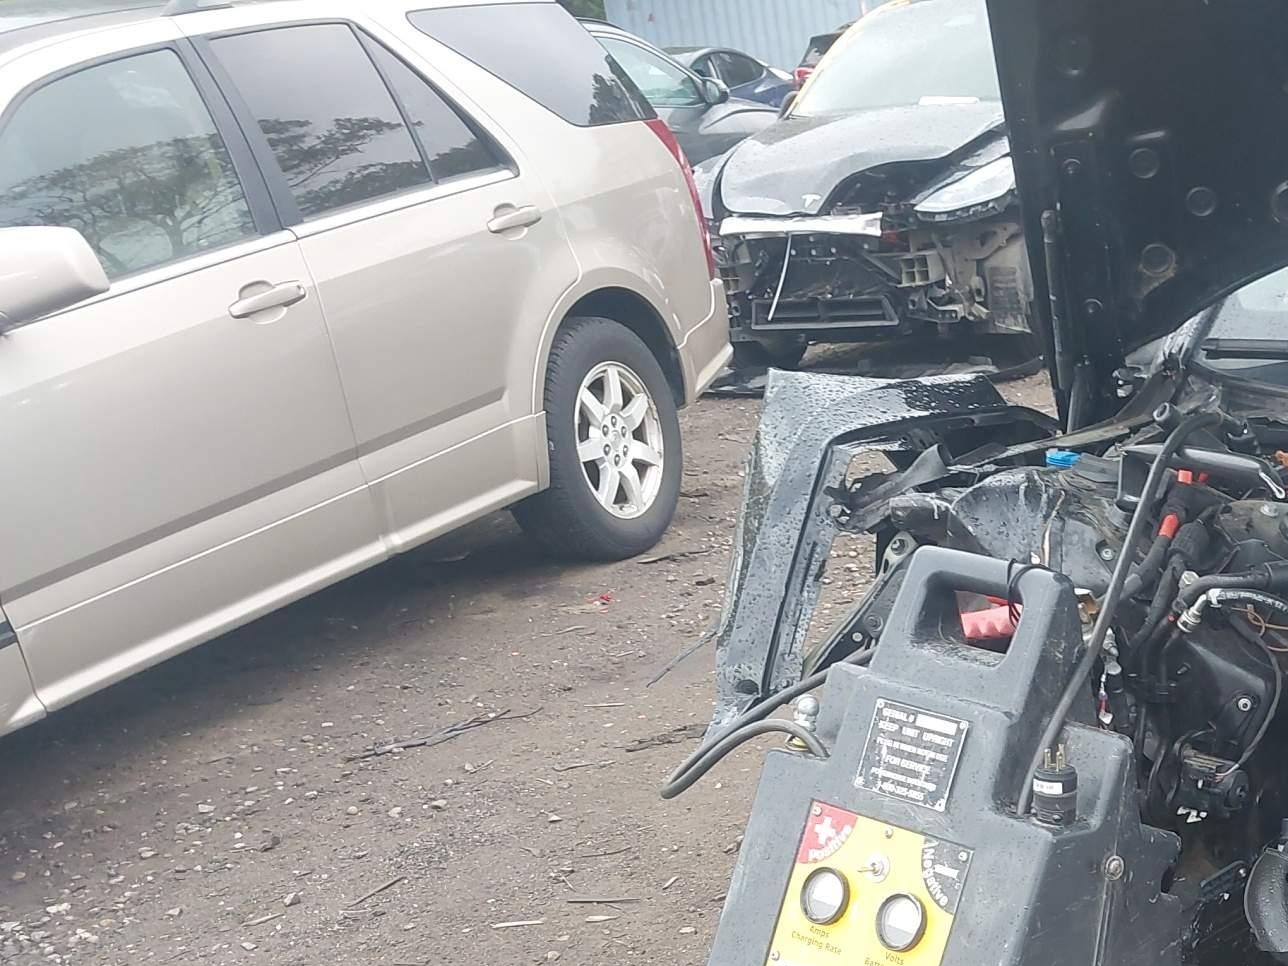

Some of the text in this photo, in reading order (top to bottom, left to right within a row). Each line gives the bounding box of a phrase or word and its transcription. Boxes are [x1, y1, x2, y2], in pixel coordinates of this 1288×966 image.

[923, 847, 949, 907] Negative
[791, 930, 823, 950] Charging
[885, 951, 904, 966] Volts
